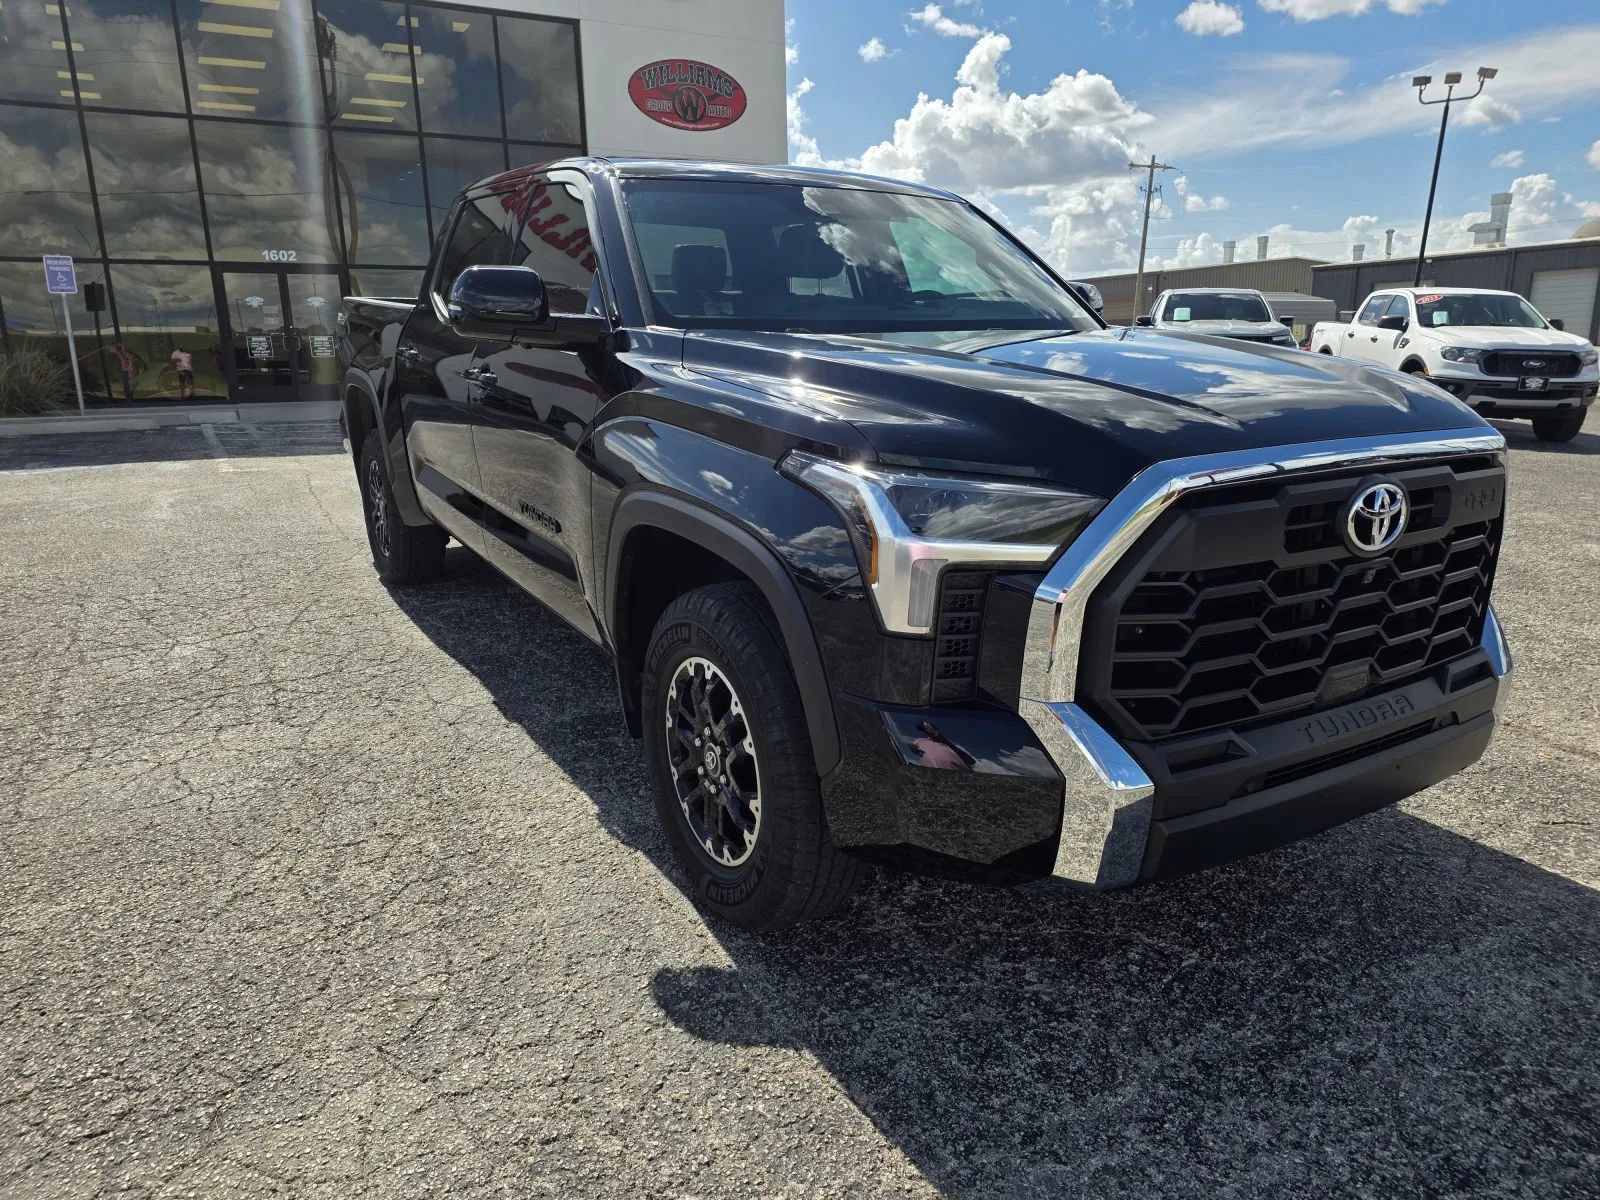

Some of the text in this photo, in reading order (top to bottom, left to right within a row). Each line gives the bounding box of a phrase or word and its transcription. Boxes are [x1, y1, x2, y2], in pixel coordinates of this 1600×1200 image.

[640, 63, 734, 98] WILLIAMS
[646, 98, 673, 112] GROUP
[262, 249, 298, 262] 1602
[1297, 694, 1415, 743] TUNDRA
